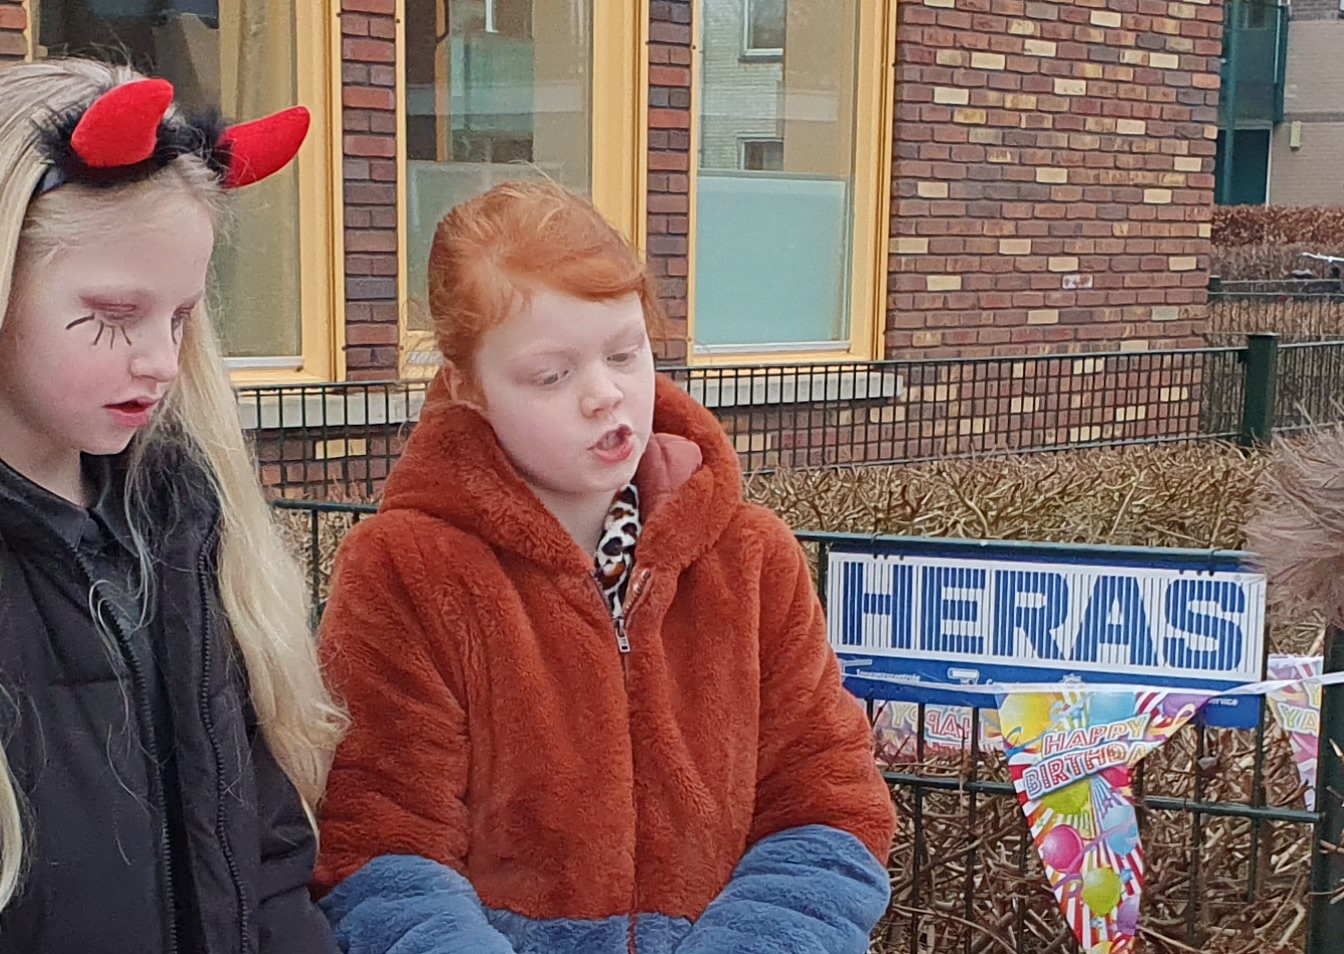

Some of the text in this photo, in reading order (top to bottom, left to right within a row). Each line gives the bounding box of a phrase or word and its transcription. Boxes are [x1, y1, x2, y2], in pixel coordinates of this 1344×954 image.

[841, 560, 1246, 672] HERAS
[1043, 714, 1150, 756] HAPPY
[1024, 741, 1158, 798] BIRTHDA
